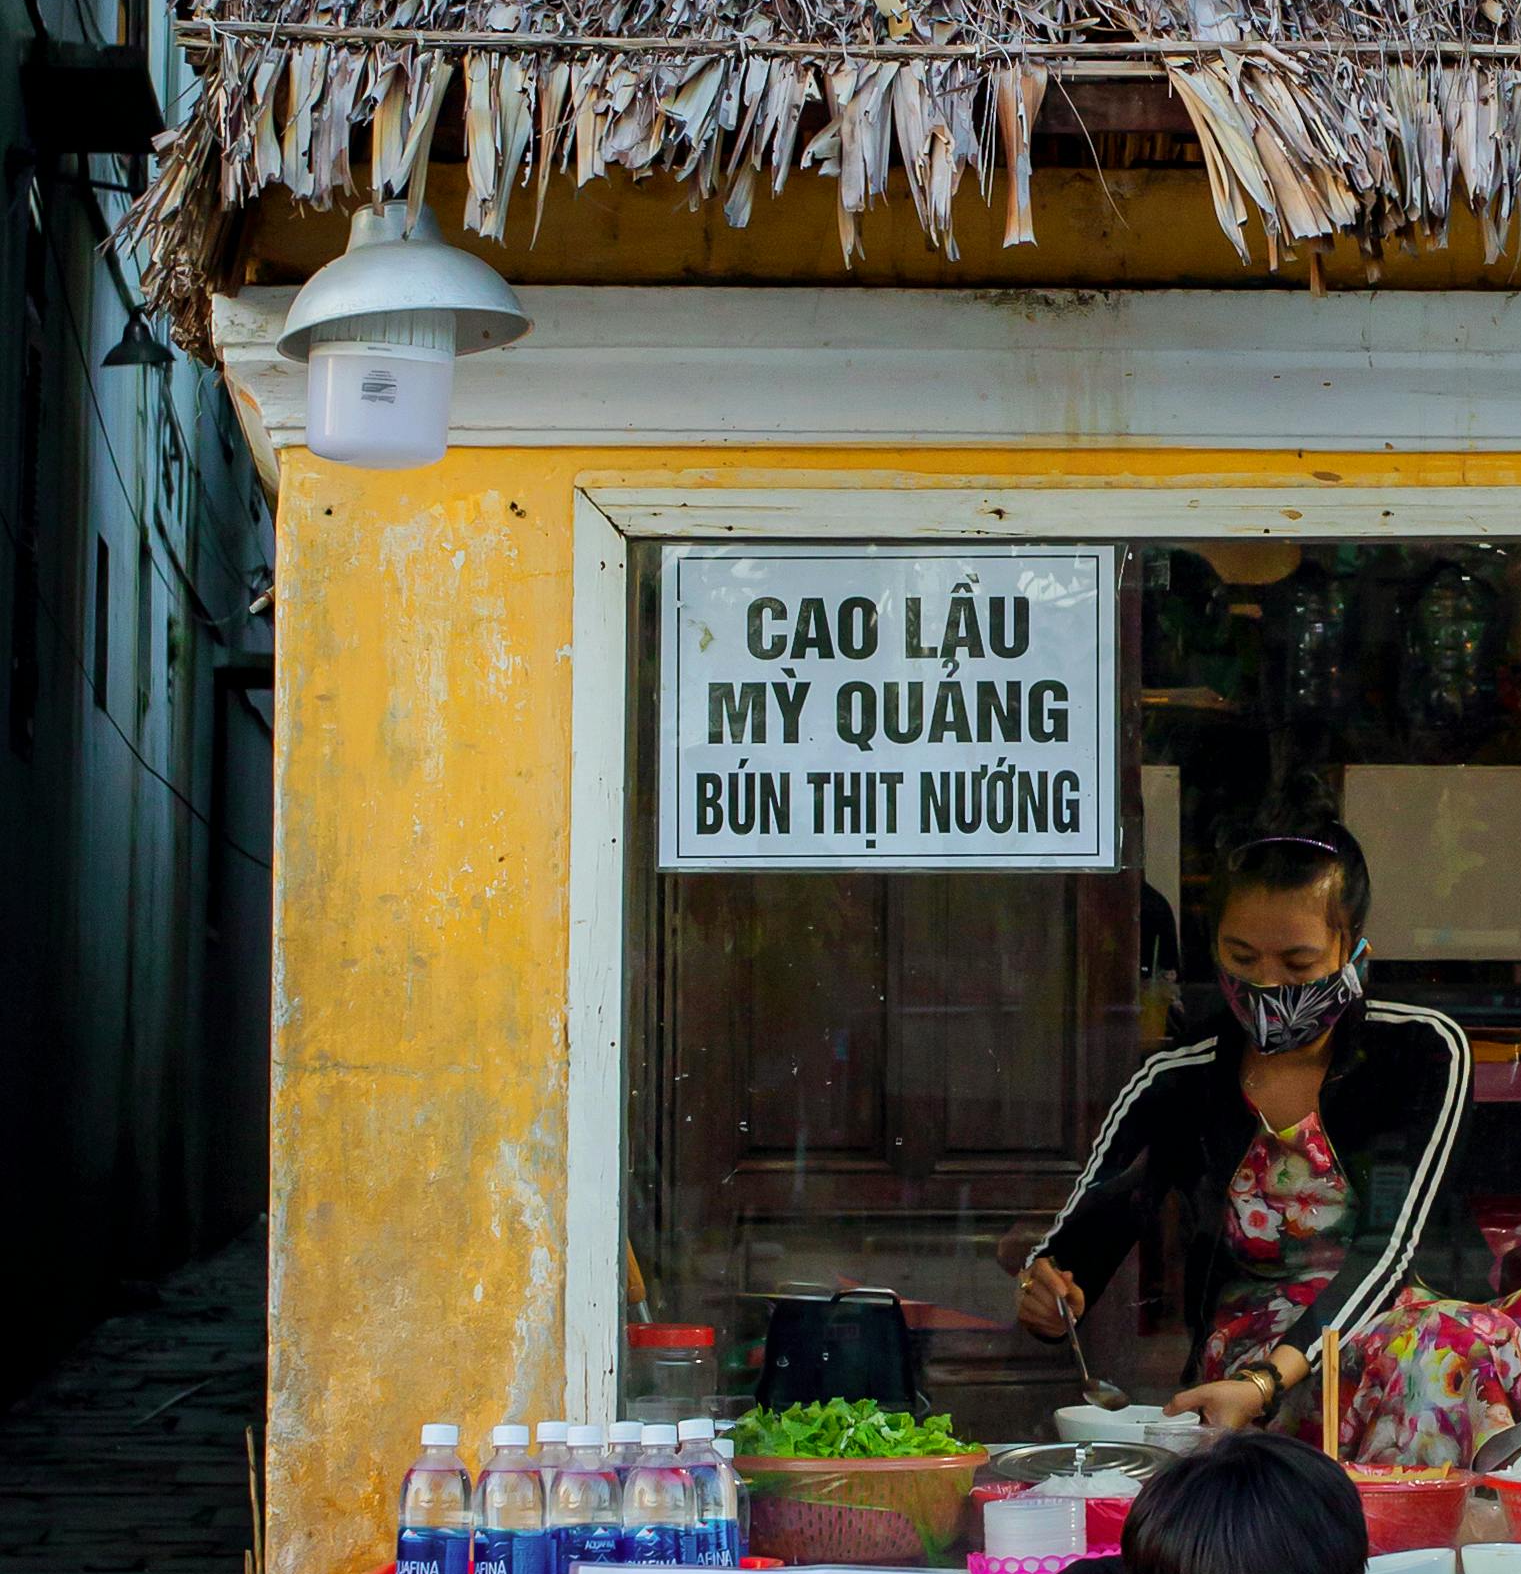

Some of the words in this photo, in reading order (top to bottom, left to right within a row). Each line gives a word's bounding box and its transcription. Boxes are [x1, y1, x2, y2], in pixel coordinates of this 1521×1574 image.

[747, 597, 878, 660] CAO
[906, 573, 1030, 659] LẦU
[708, 668, 811, 744] MỲ
[836, 658, 1069, 752] QUẢNG
[696, 759, 790, 835] BÚN
[807, 772, 904, 850] THỊT
[920, 757, 1081, 834] NƯỚNG
